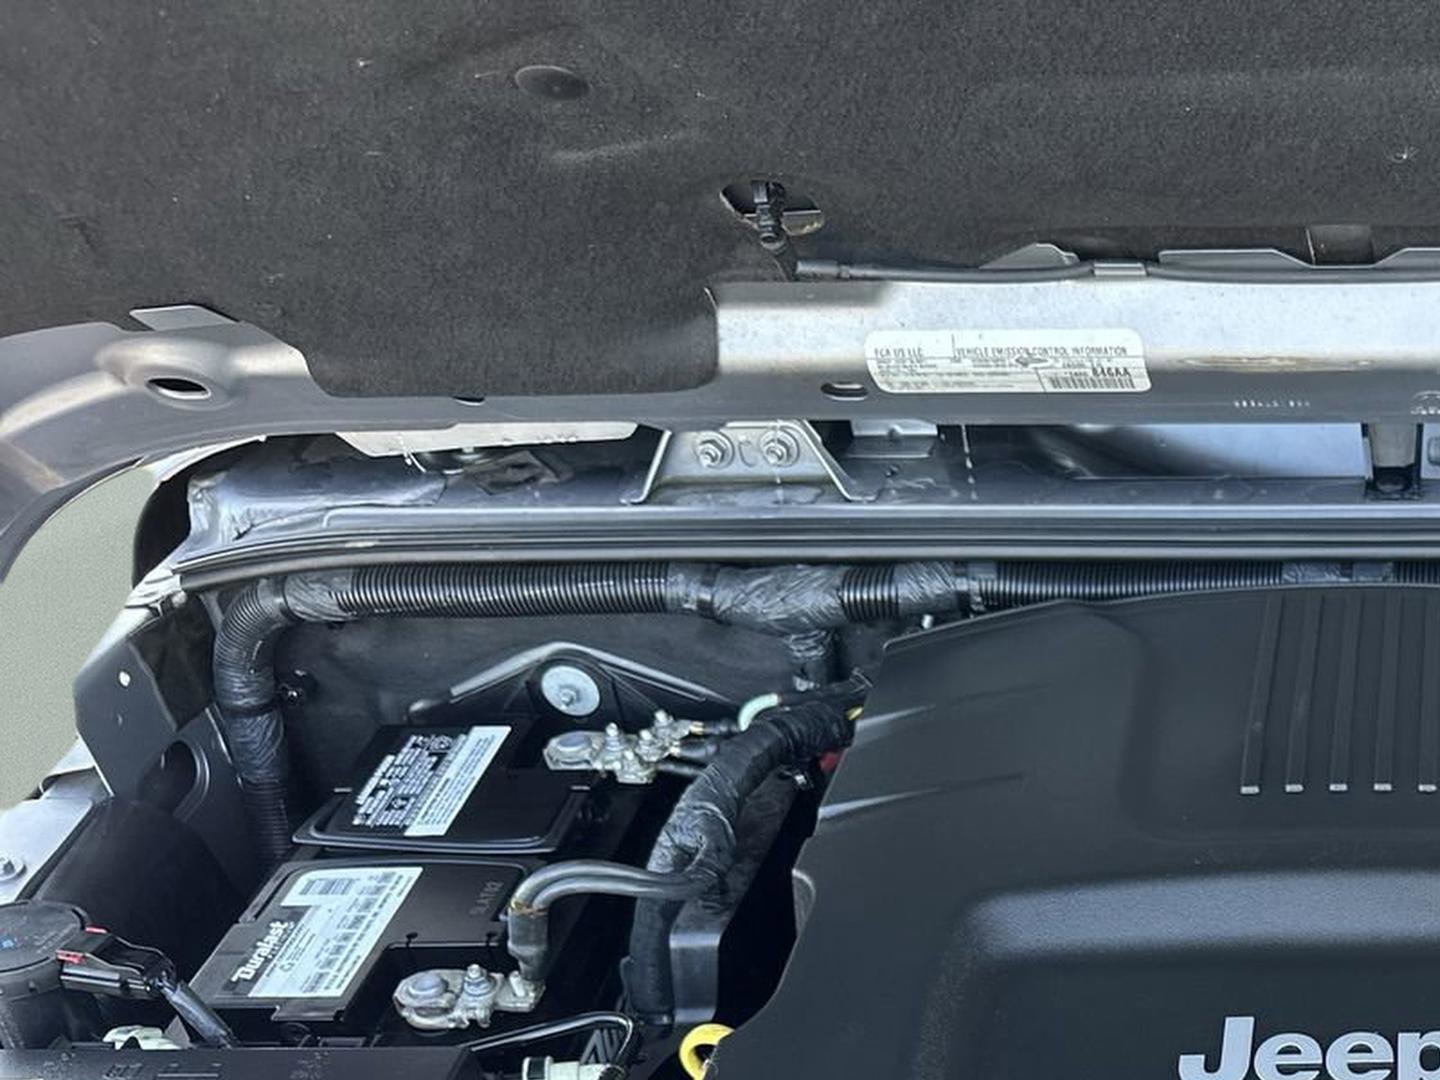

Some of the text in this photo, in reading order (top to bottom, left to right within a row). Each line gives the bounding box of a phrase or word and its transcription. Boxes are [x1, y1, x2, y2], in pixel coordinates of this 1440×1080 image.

[956, 346, 1128, 358] VEHICLE EMISSION CONTROL INFORMATION
[231, 920, 290, 983] Duralast
